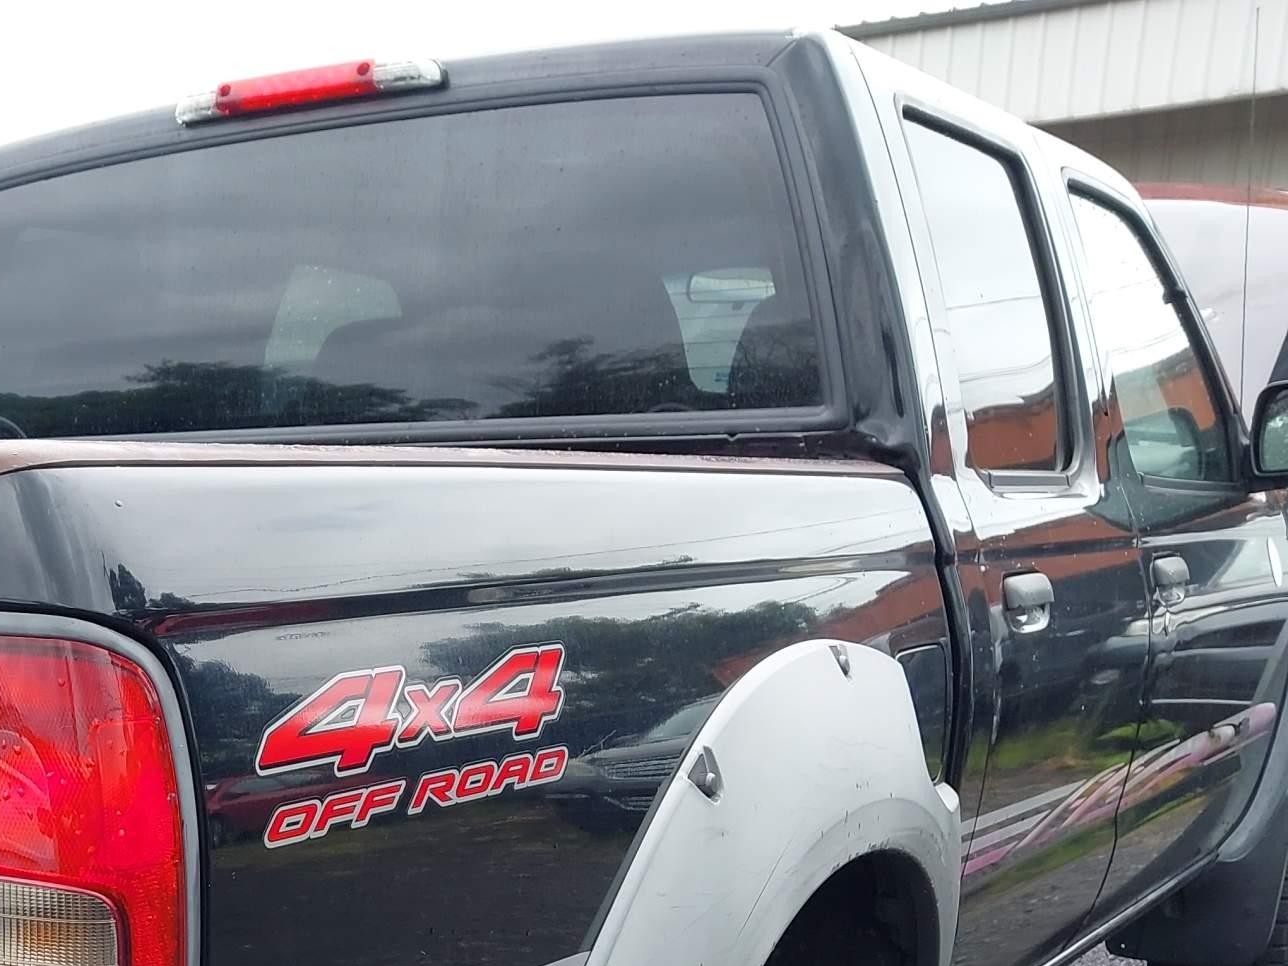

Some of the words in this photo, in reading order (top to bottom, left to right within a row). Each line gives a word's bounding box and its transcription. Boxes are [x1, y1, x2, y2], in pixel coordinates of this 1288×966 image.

[255, 643, 567, 777] 4x4
[264, 779, 406, 849] OFF
[408, 745, 568, 815] ROAD
